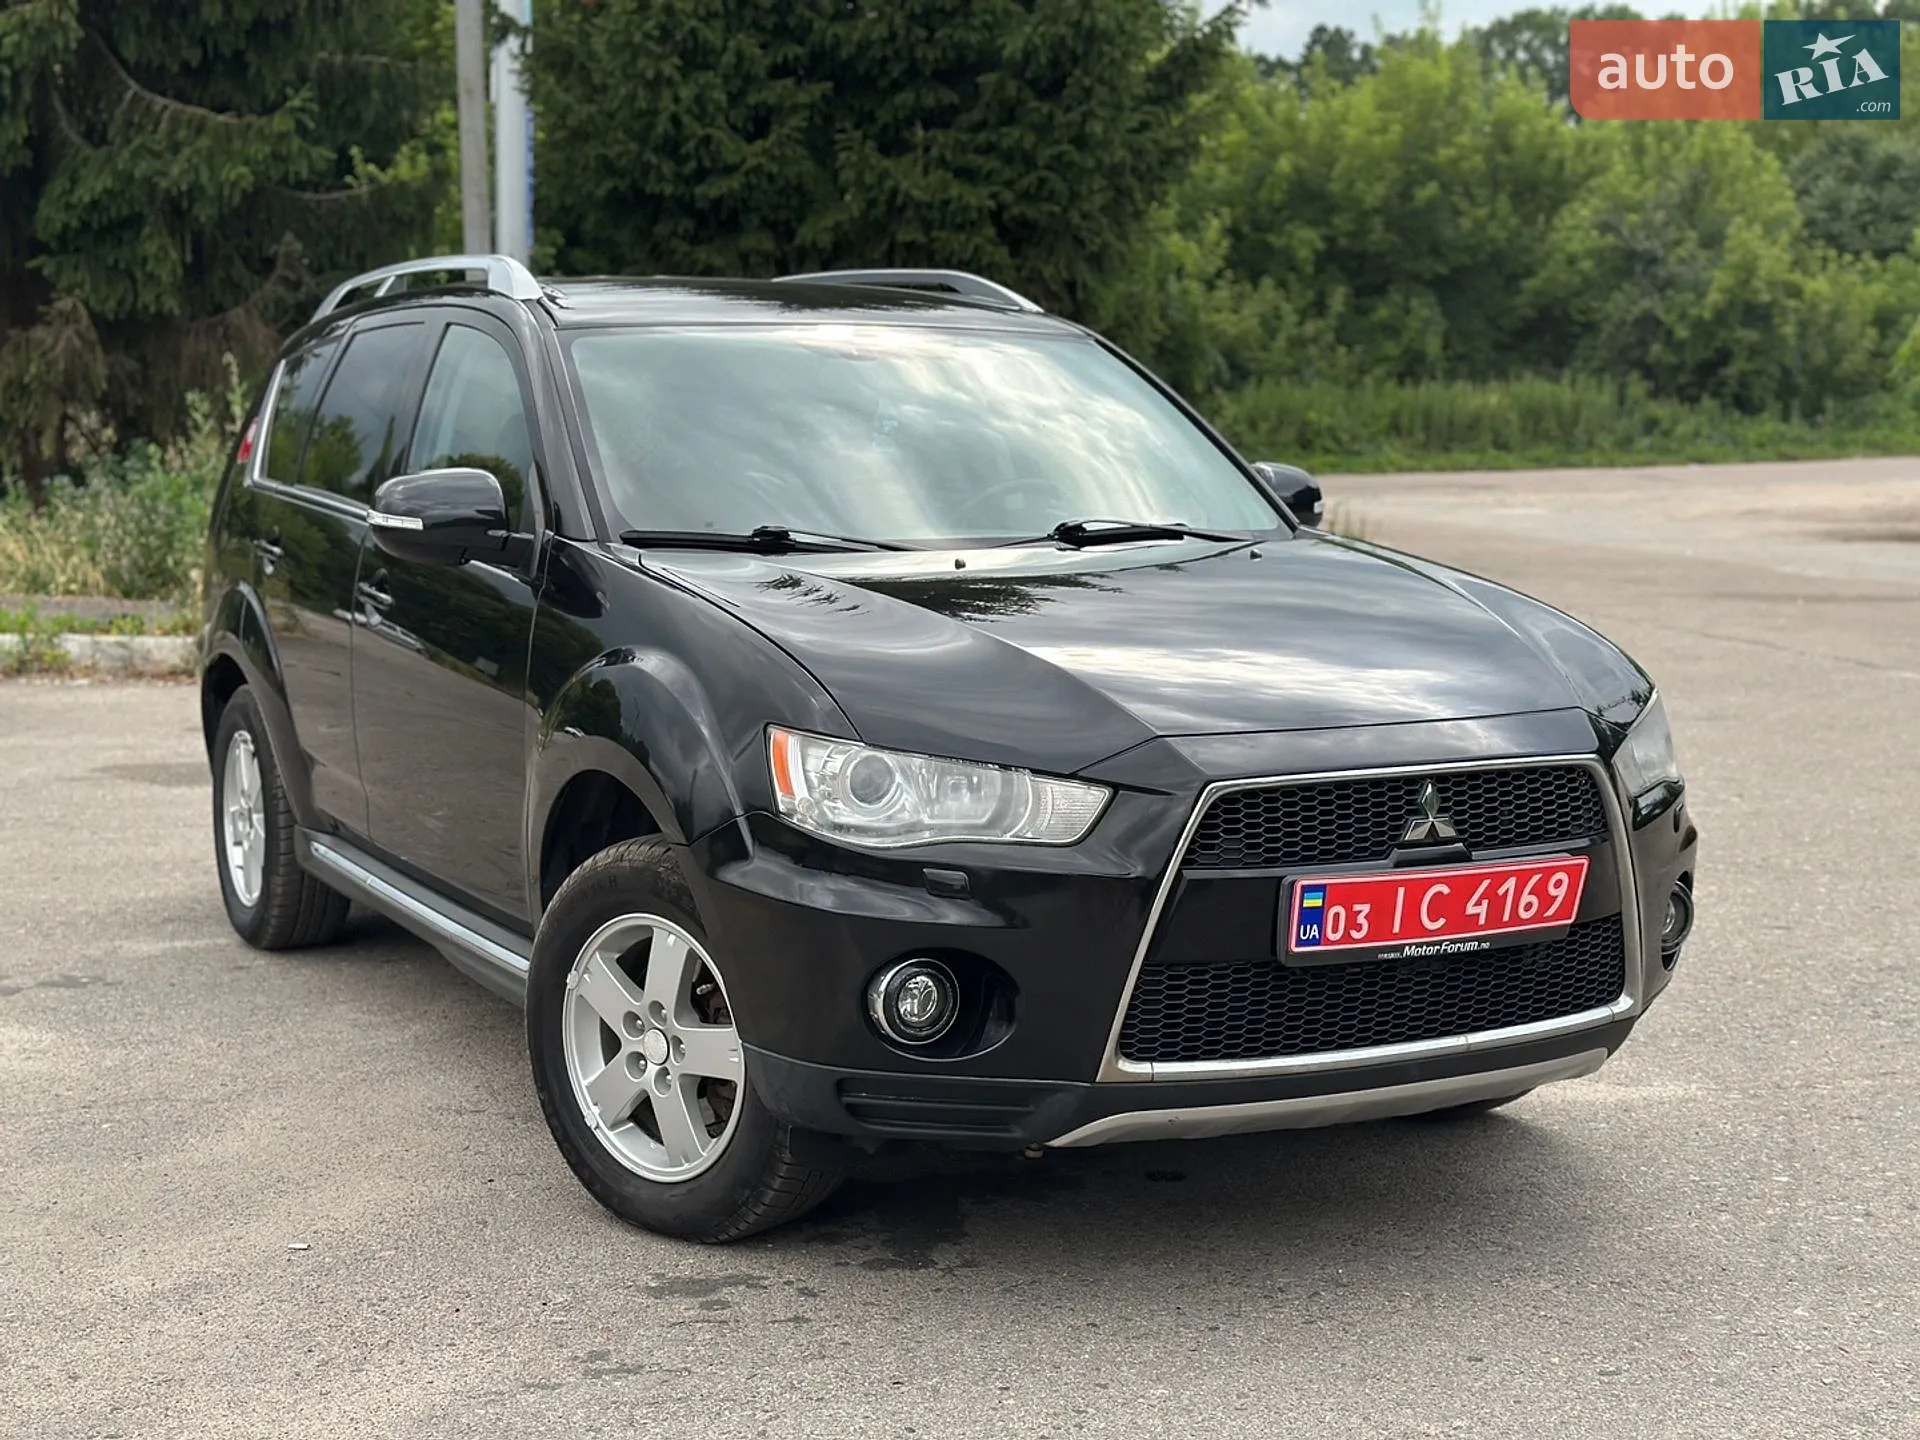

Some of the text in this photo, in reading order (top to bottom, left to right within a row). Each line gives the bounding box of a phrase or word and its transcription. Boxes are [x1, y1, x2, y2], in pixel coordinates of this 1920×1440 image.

[1326, 903, 1371, 941] 03
[1465, 871, 1569, 925] 4169
[1300, 923, 1319, 940] UA
